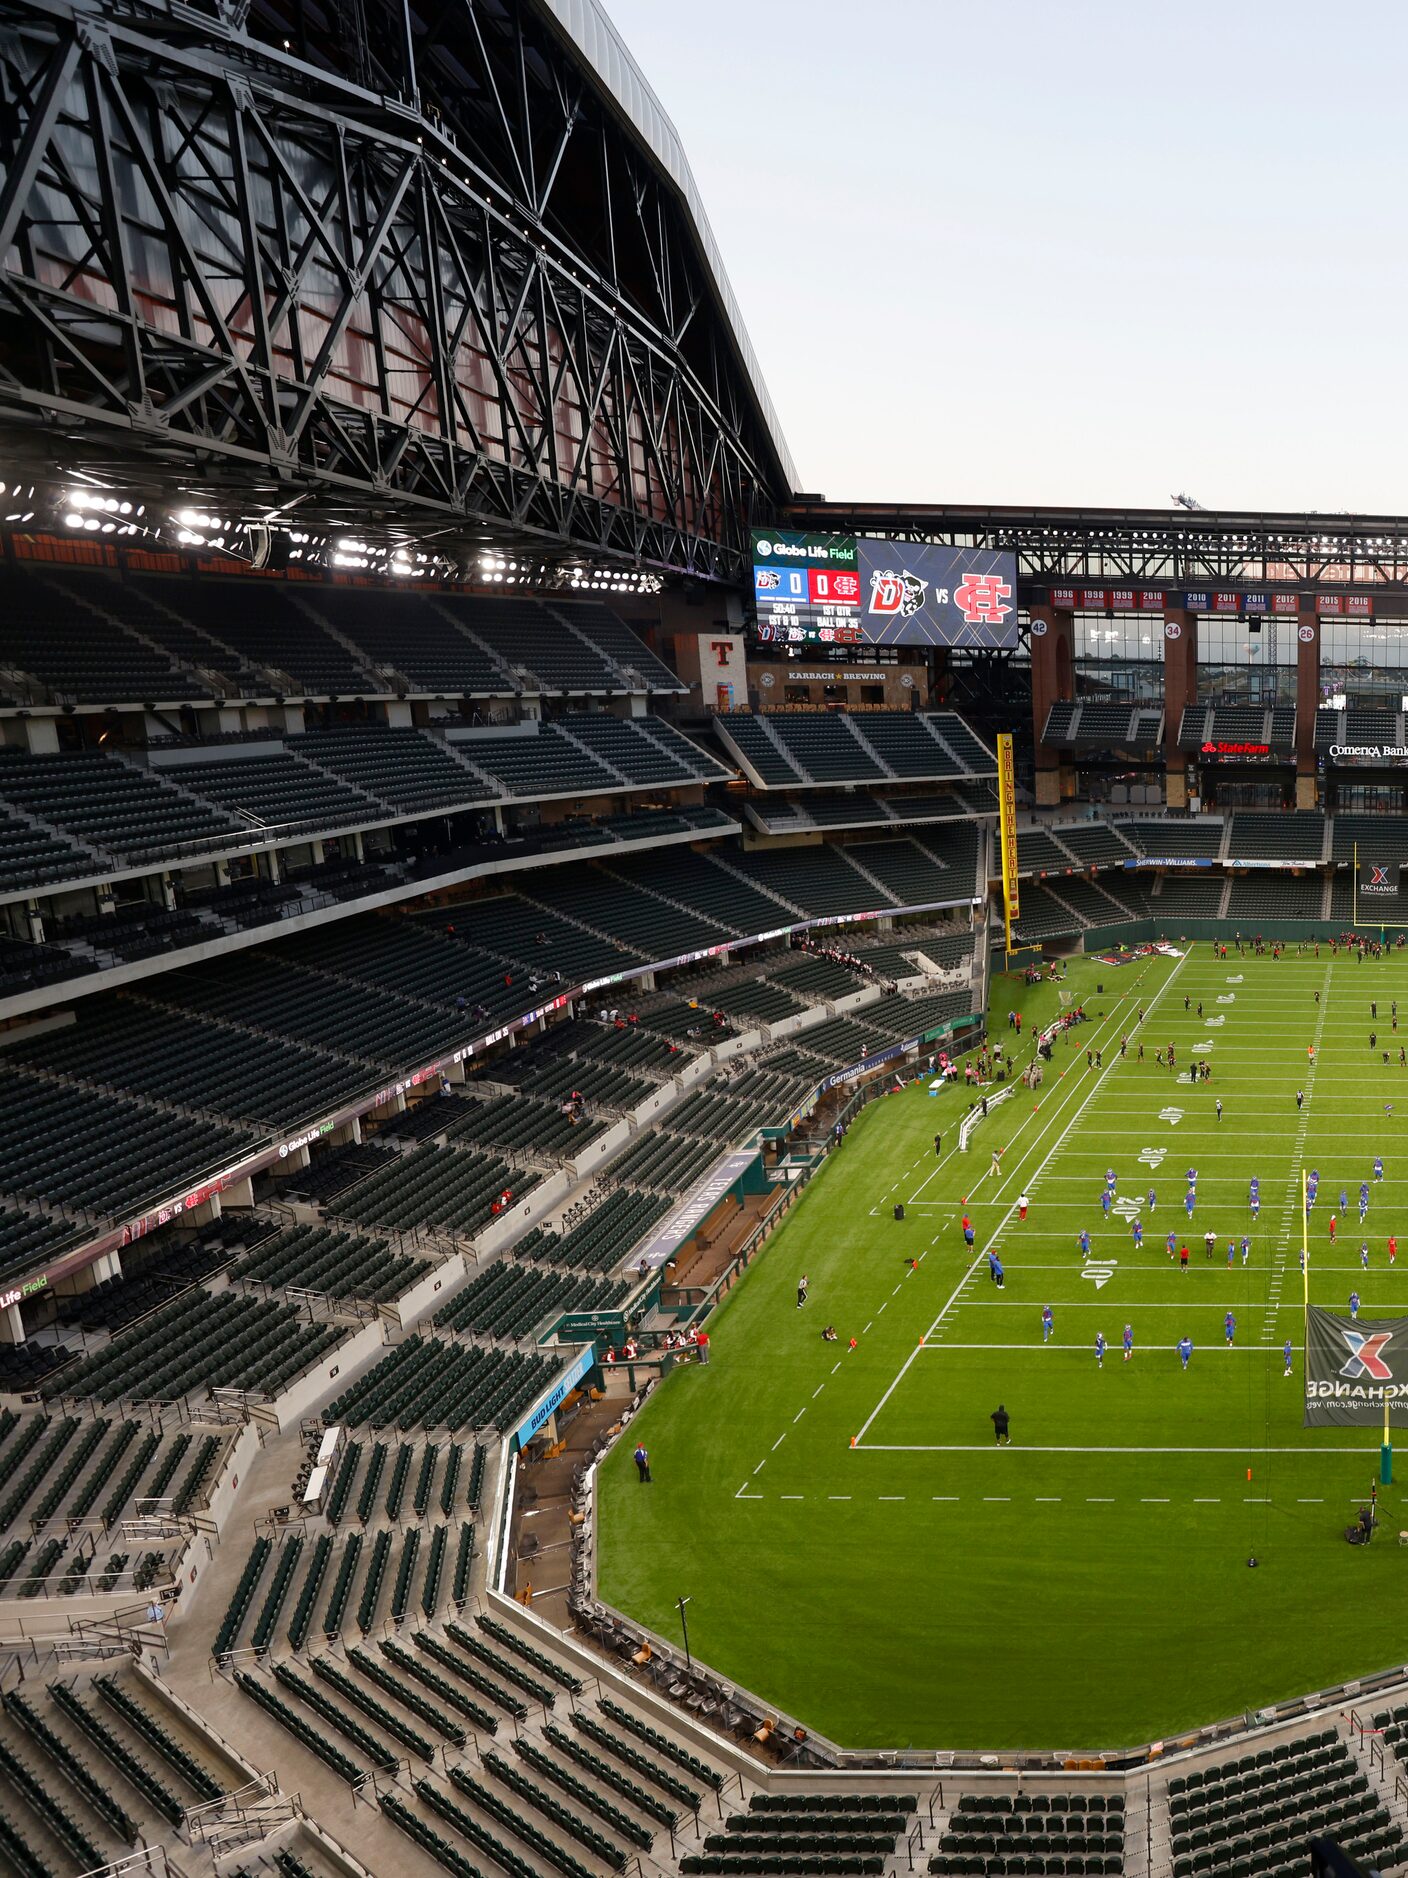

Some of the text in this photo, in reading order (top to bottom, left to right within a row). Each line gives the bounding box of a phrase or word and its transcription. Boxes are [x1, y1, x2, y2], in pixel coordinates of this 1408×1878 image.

[773, 543, 854, 560] Globe Life Field
[790, 573, 801, 594] 0
[817, 575, 828, 595] 0
[935, 588, 948, 604] VS
[1054, 590, 1073, 598] 1996
[1084, 590, 1104, 599] 1998
[1112, 591, 1133, 600] 1999
[1143, 592, 1162, 600] 2010
[1187, 593, 1207, 601] 2010
[1218, 594, 1236, 602] 2011
[1247, 595, 1265, 603] 2011
[1276, 595, 1295, 603] 2012
[1319, 596, 1339, 604] 2015
[1349, 597, 1368, 606] 2016
[817, 617, 858, 628] BALL ON 35
[1033, 622, 1046, 633] 42
[1167, 626, 1180, 636] 34
[1300, 629, 1313, 639] 26
[711, 642, 733, 665] T
[788, 672, 835, 680] KARBACH
[1005, 750, 1013, 802] BRING
[1008, 840, 1016, 878] HEAT
[1361, 884, 1398, 892] EXCHANGE
[829, 1063, 866, 1087] Germania
[288, 1120, 334, 1153] Globe Life Field
[697, 1177, 733, 1202] TEXAS
[662, 1203, 709, 1240] RANGERS
[0, 1276, 48, 1309] Life Field
[531, 1385, 565, 1429] BUD LIGHT
